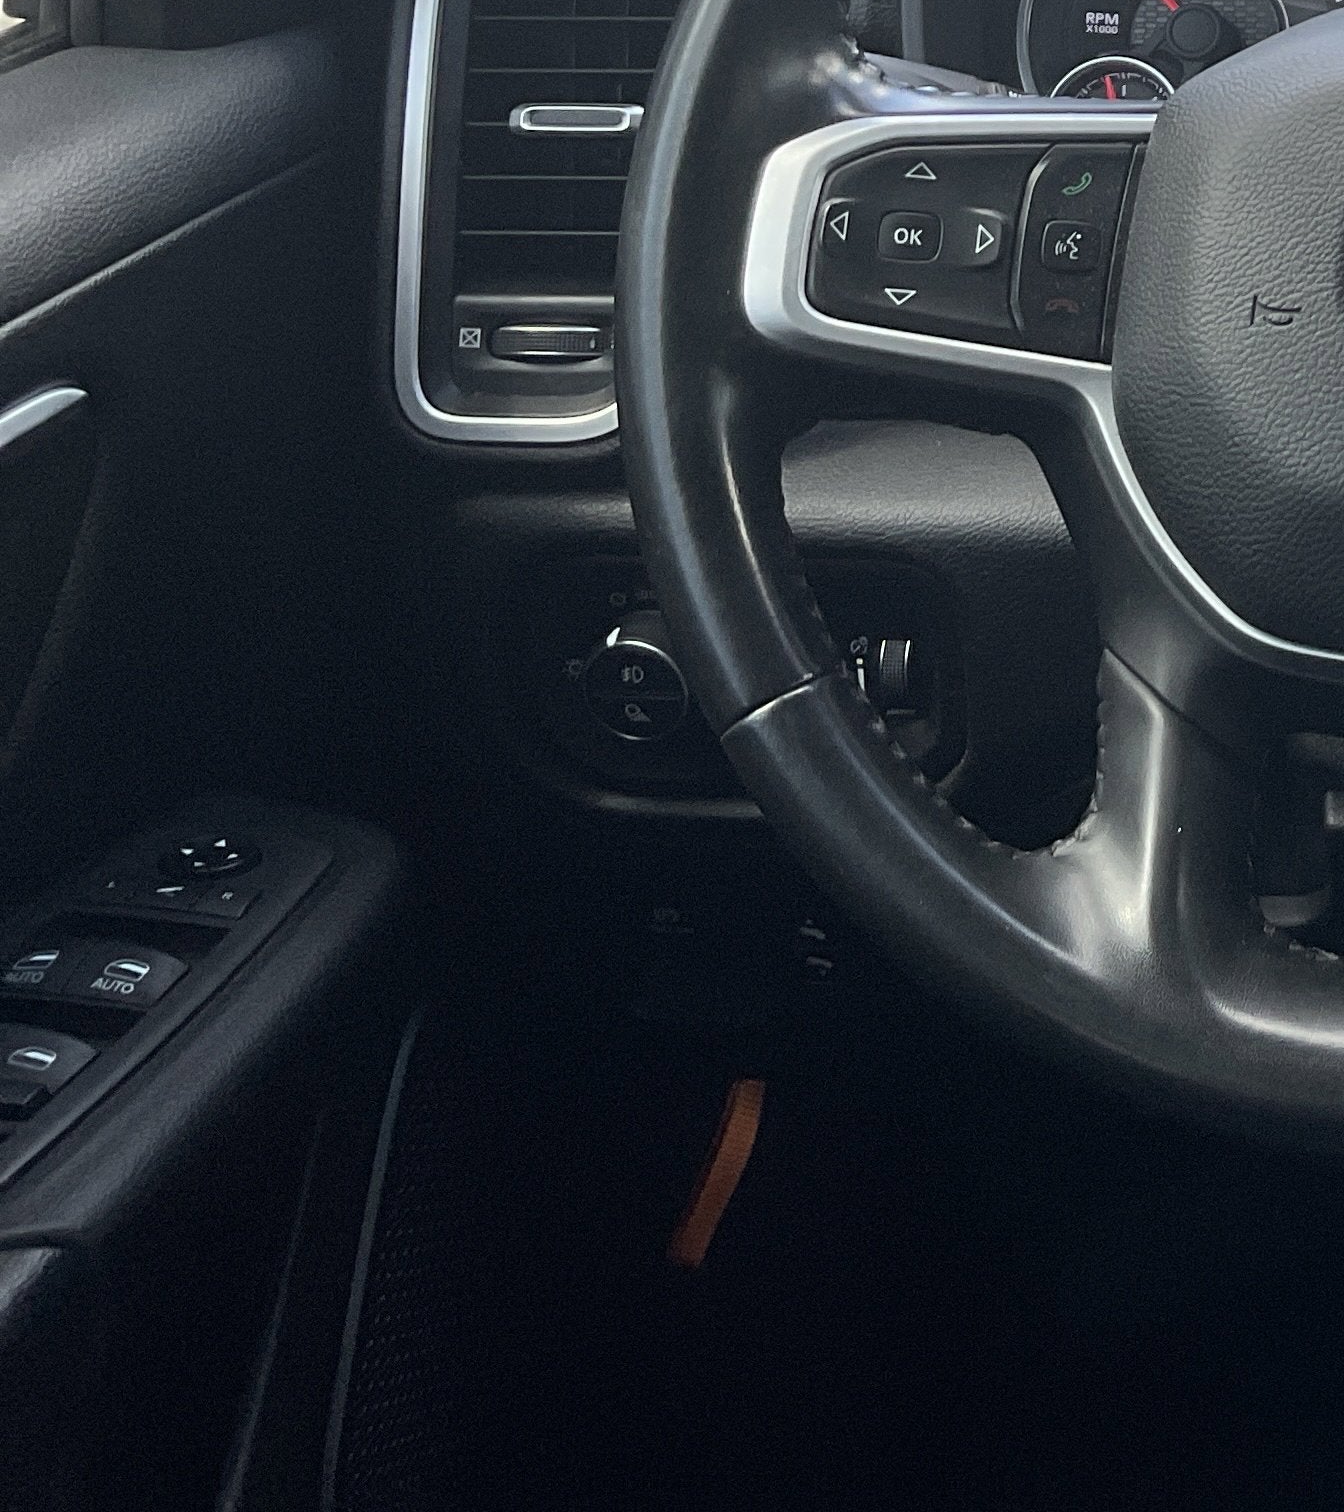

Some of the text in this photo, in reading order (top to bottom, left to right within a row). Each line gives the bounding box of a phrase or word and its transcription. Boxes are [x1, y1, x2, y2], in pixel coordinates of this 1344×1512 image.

[1085, 11, 1119, 26] RPM
[1085, 24, 1119, 35] X1000
[893, 227, 923, 247] OK
[90, 978, 135, 995] AUTO
